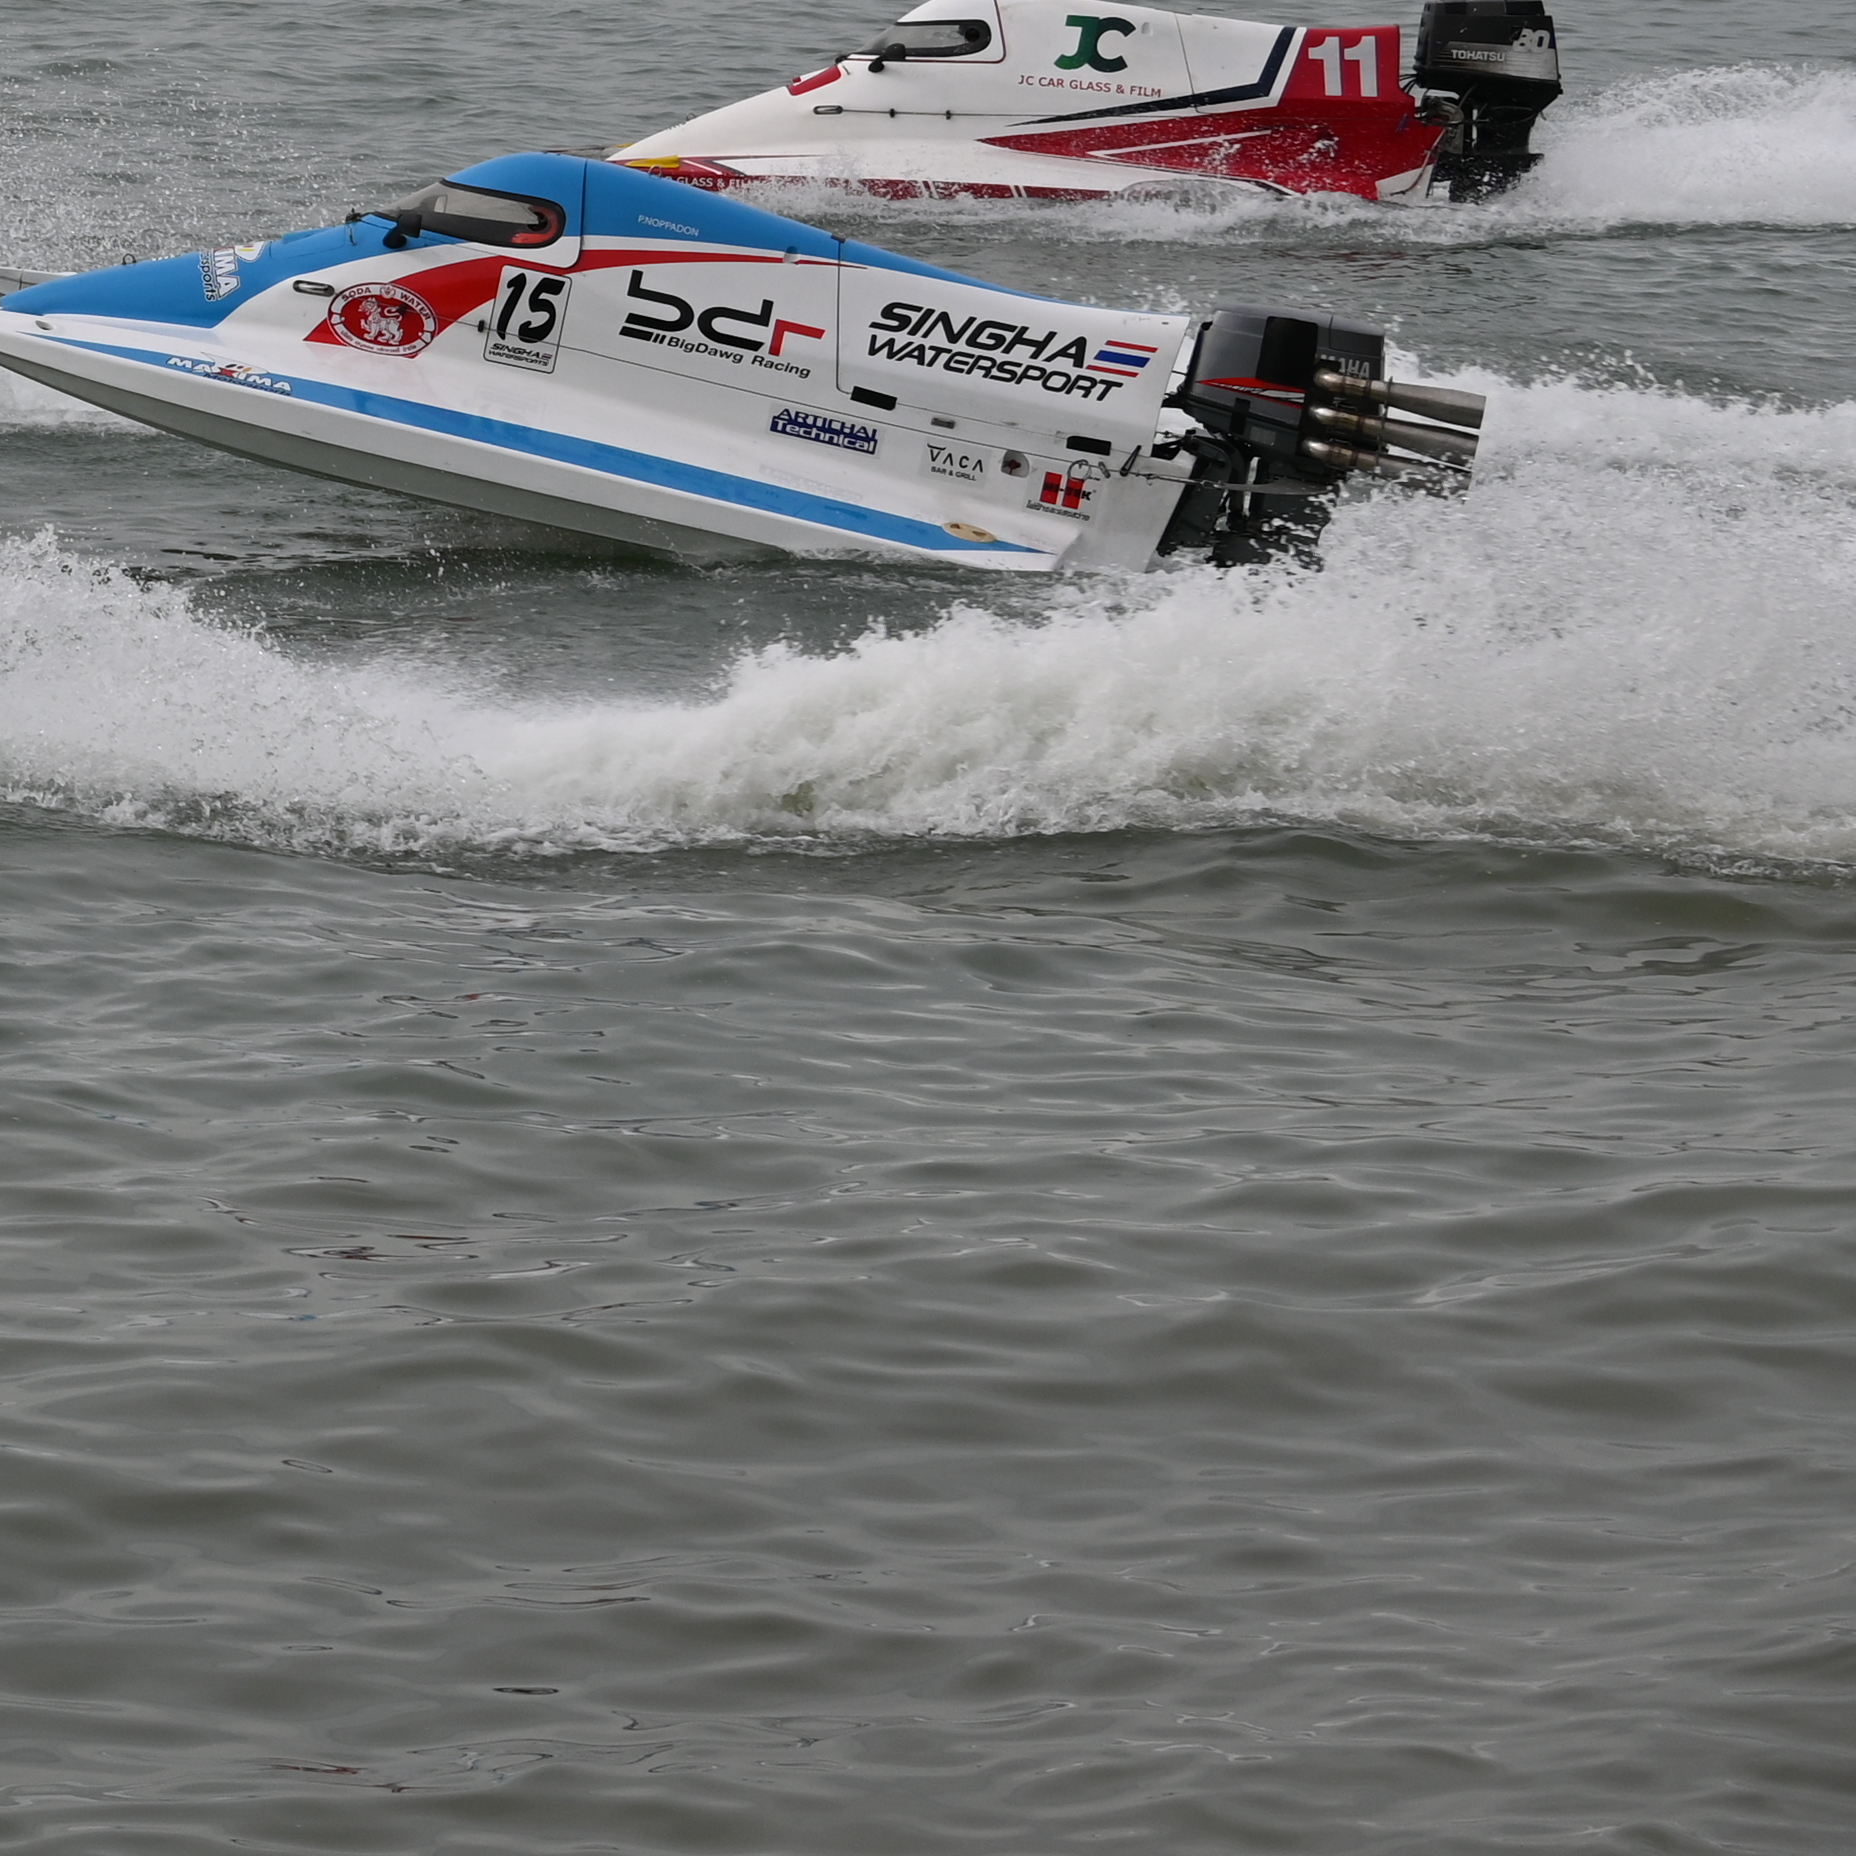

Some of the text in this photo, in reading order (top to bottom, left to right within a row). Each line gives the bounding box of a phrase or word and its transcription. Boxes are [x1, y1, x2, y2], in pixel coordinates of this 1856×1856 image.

[1054, 14, 1136, 73] JC
[1451, 49, 1506, 62] TOHATSU
[1308, 35, 1378, 97] 11
[1018, 75, 1162, 98] JC CAR GLASS & FILM
[341, 286, 431, 321] SODA WATER
[497, 272, 565, 343] 15
[491, 343, 543, 359] SINGHA
[868, 301, 1087, 369] SINGHA
[667, 336, 811, 379] BigDawg Racing
[868, 334, 1123, 401] WATERSPORT
[774, 419, 875, 452] Technical
[927, 443, 984, 473] VACA
[931, 466, 947, 476] BAR
[955, 471, 977, 482] GRILL
